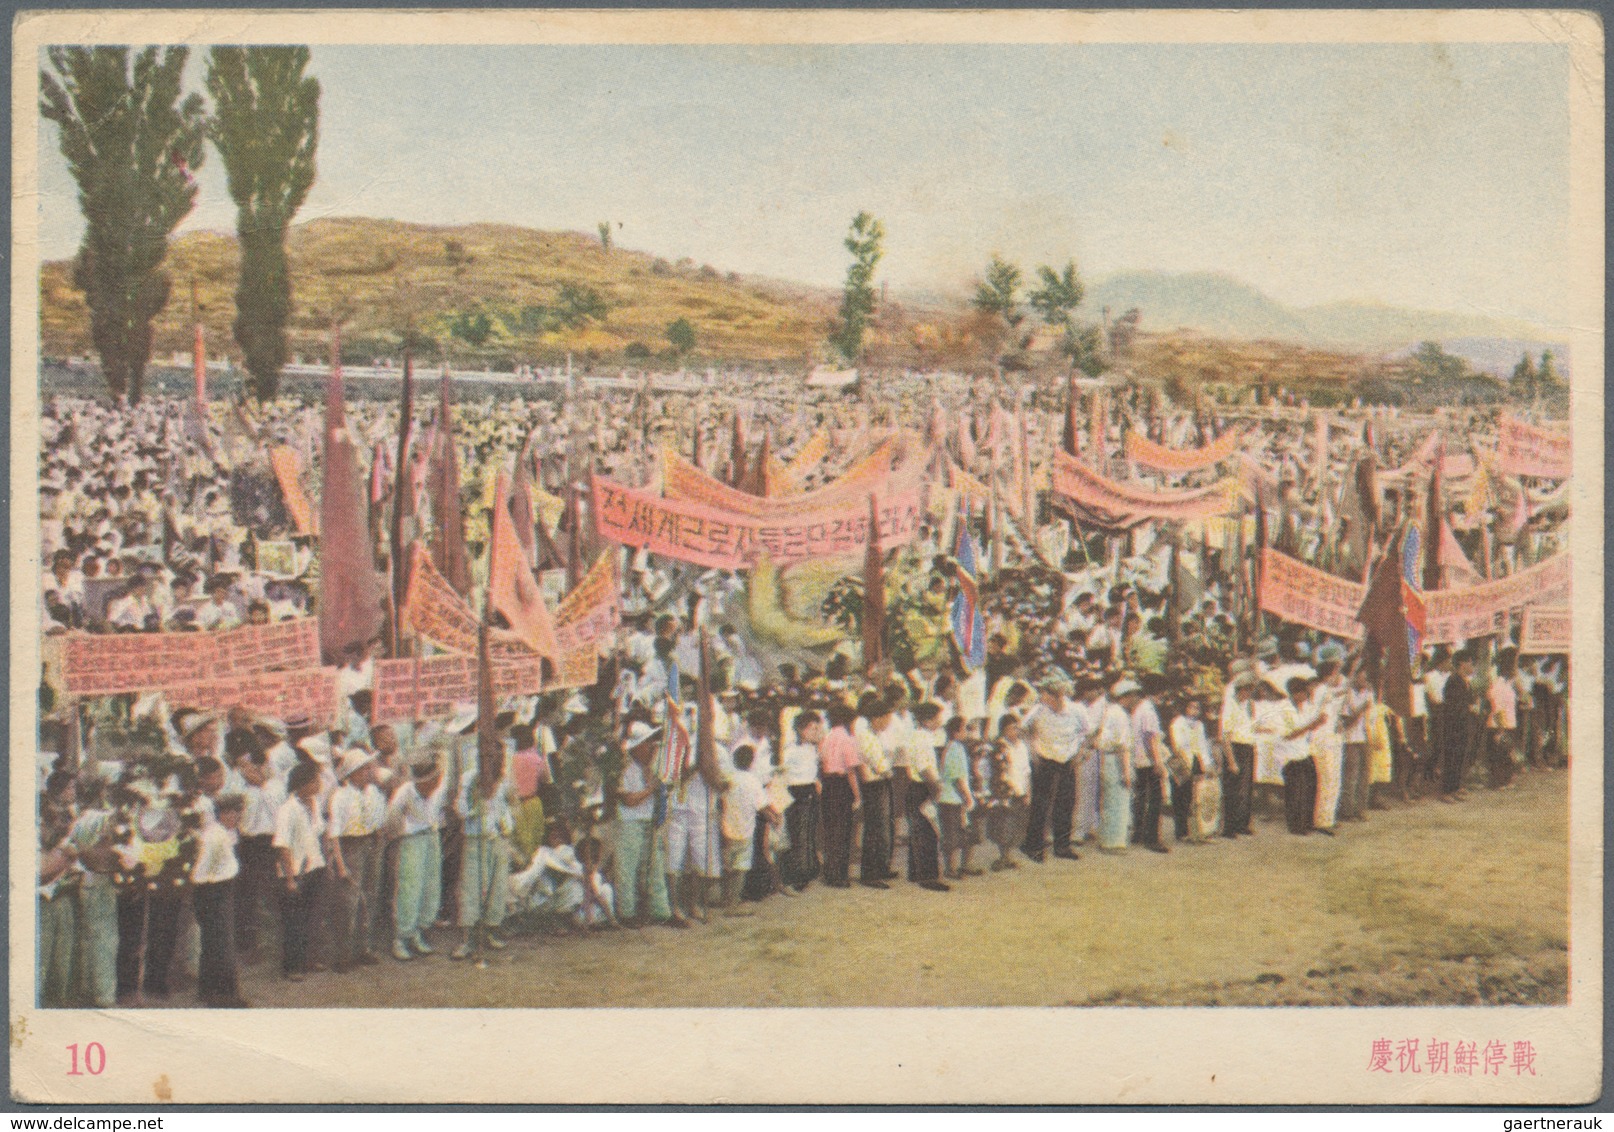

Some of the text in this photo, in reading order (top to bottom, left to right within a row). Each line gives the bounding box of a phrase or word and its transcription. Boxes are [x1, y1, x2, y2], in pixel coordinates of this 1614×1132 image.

[66, 1041, 106, 1075] 10
[1366, 1037, 1537, 1076] 慶祝朝鮮停戰
